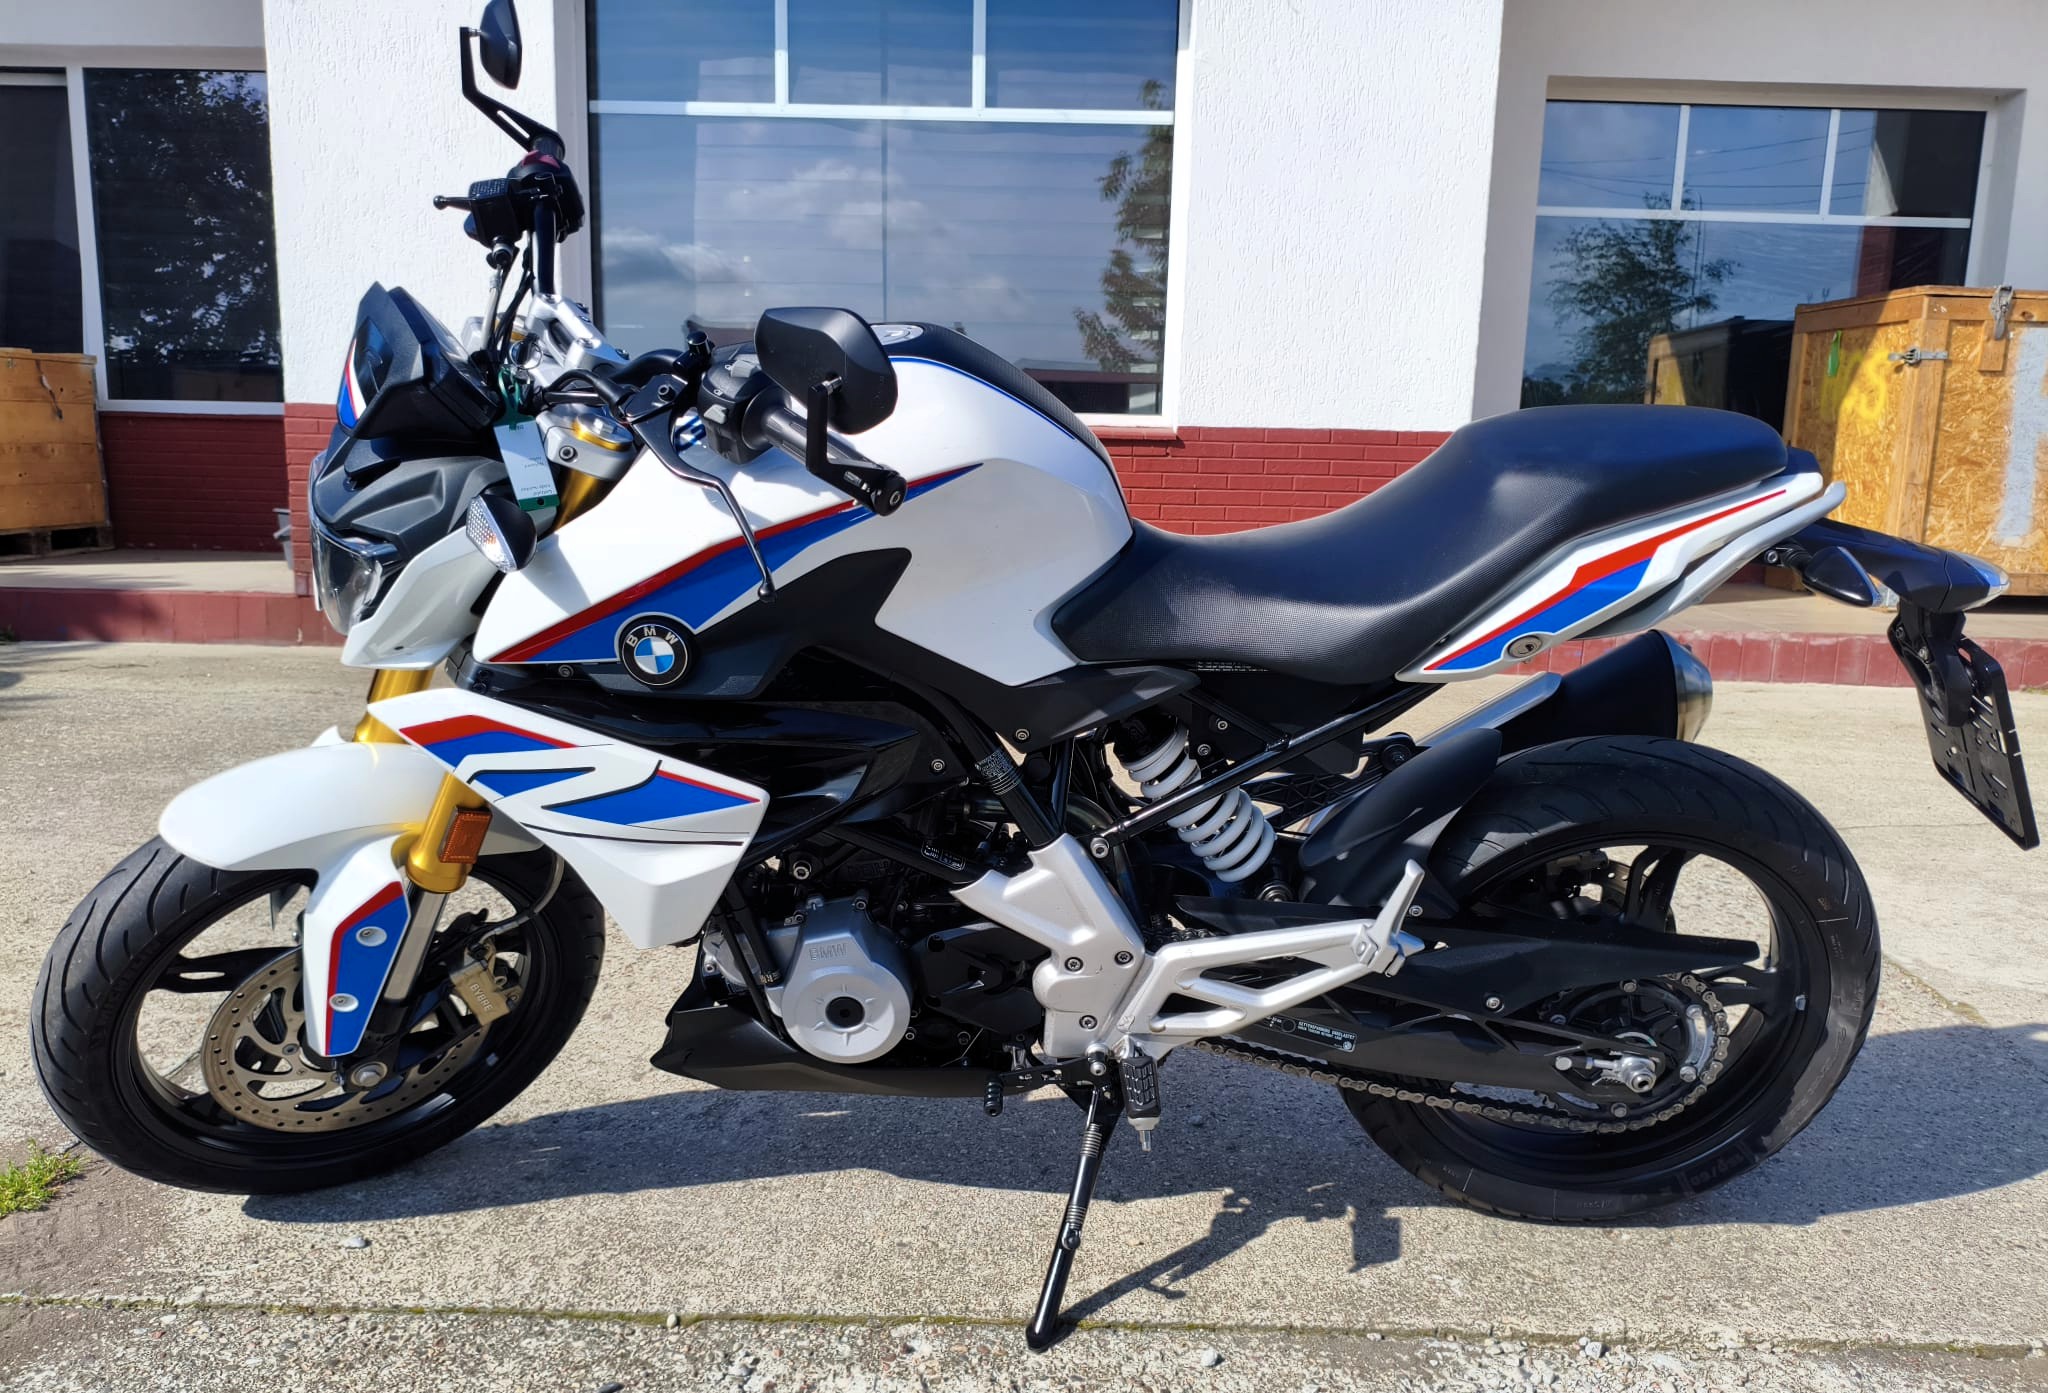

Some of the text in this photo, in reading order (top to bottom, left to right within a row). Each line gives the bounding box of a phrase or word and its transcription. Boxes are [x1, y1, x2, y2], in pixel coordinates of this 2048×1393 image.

[626, 626, 679, 648] BMW
[808, 943, 849, 961] BMW
[470, 983, 494, 1011] BYBRE
